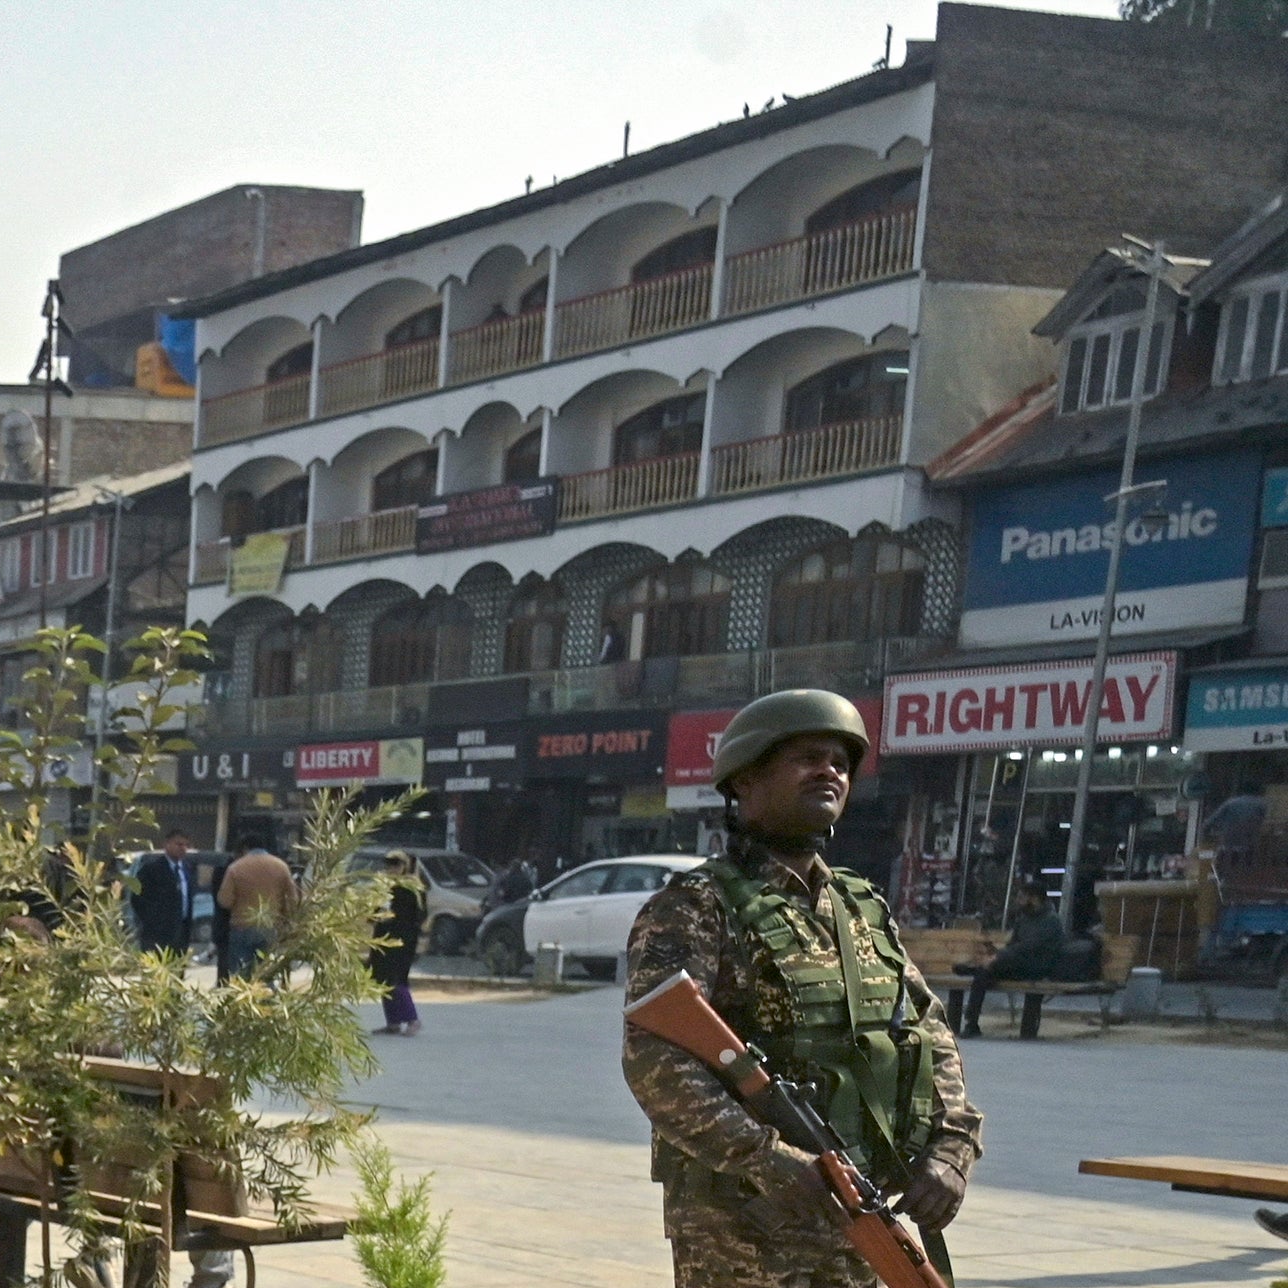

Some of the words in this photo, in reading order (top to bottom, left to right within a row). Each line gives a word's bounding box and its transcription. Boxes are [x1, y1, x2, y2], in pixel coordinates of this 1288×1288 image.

[1000, 503, 1218, 565] Panasonic
[894, 675, 1161, 737] RIGHTWAY
[301, 747, 373, 769] LIBERTY
[538, 733, 589, 758] ZERO
[592, 729, 653, 754] POINT
[192, 755, 209, 780] U
[216, 753, 234, 779] &
